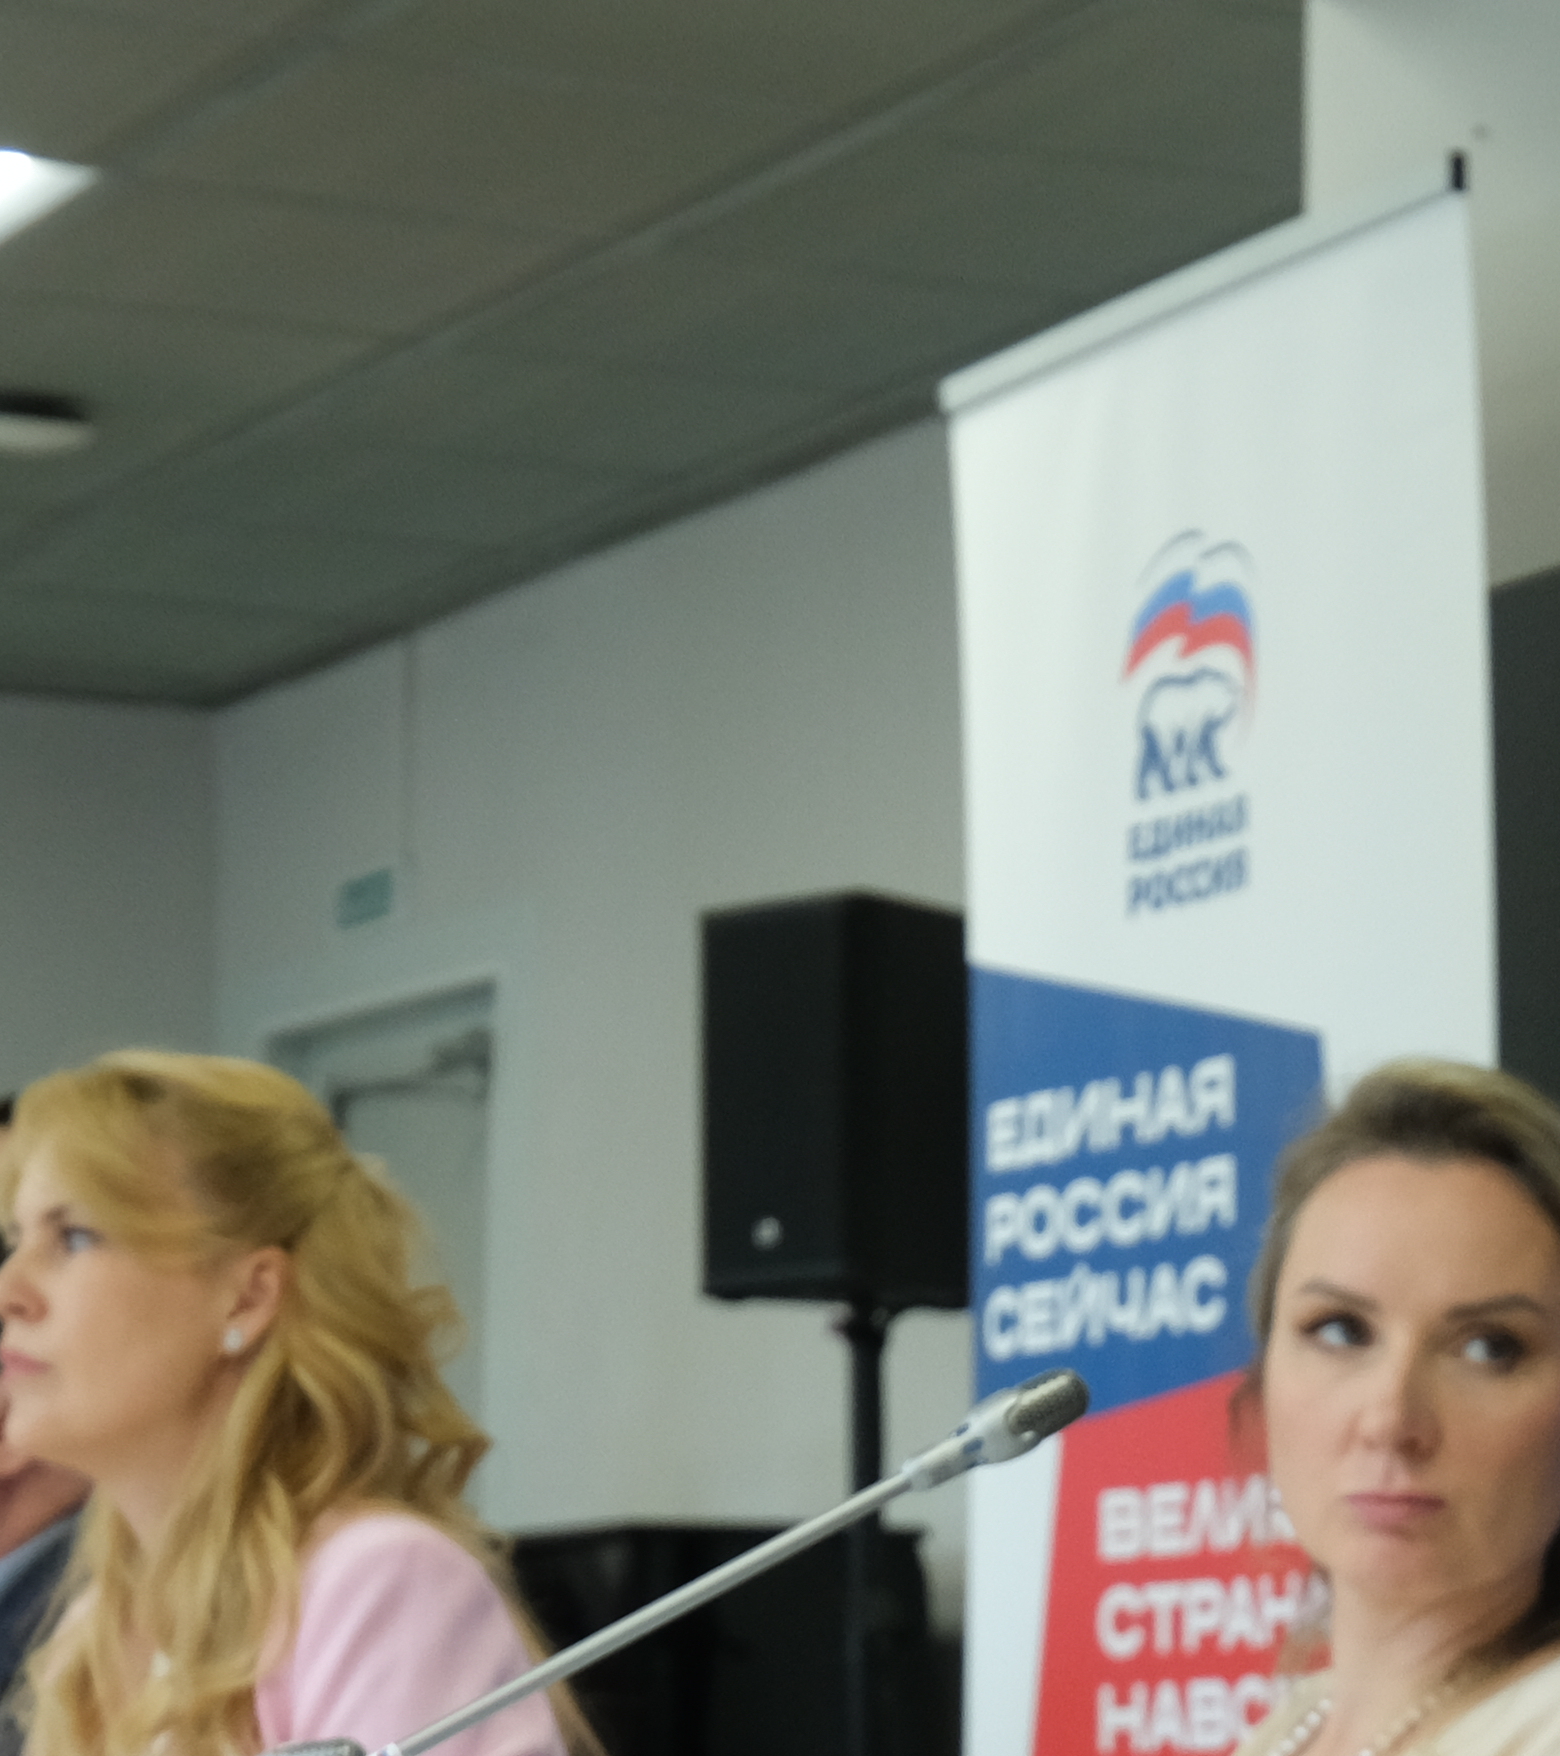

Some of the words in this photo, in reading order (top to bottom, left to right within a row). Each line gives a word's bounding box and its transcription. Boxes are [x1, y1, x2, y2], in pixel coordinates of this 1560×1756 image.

[986, 1053, 1237, 1172] ЕДИНАЯ
[985, 1155, 1237, 1264] РОССИЯ
[985, 1255, 1228, 1361] СЕЙЧАС
